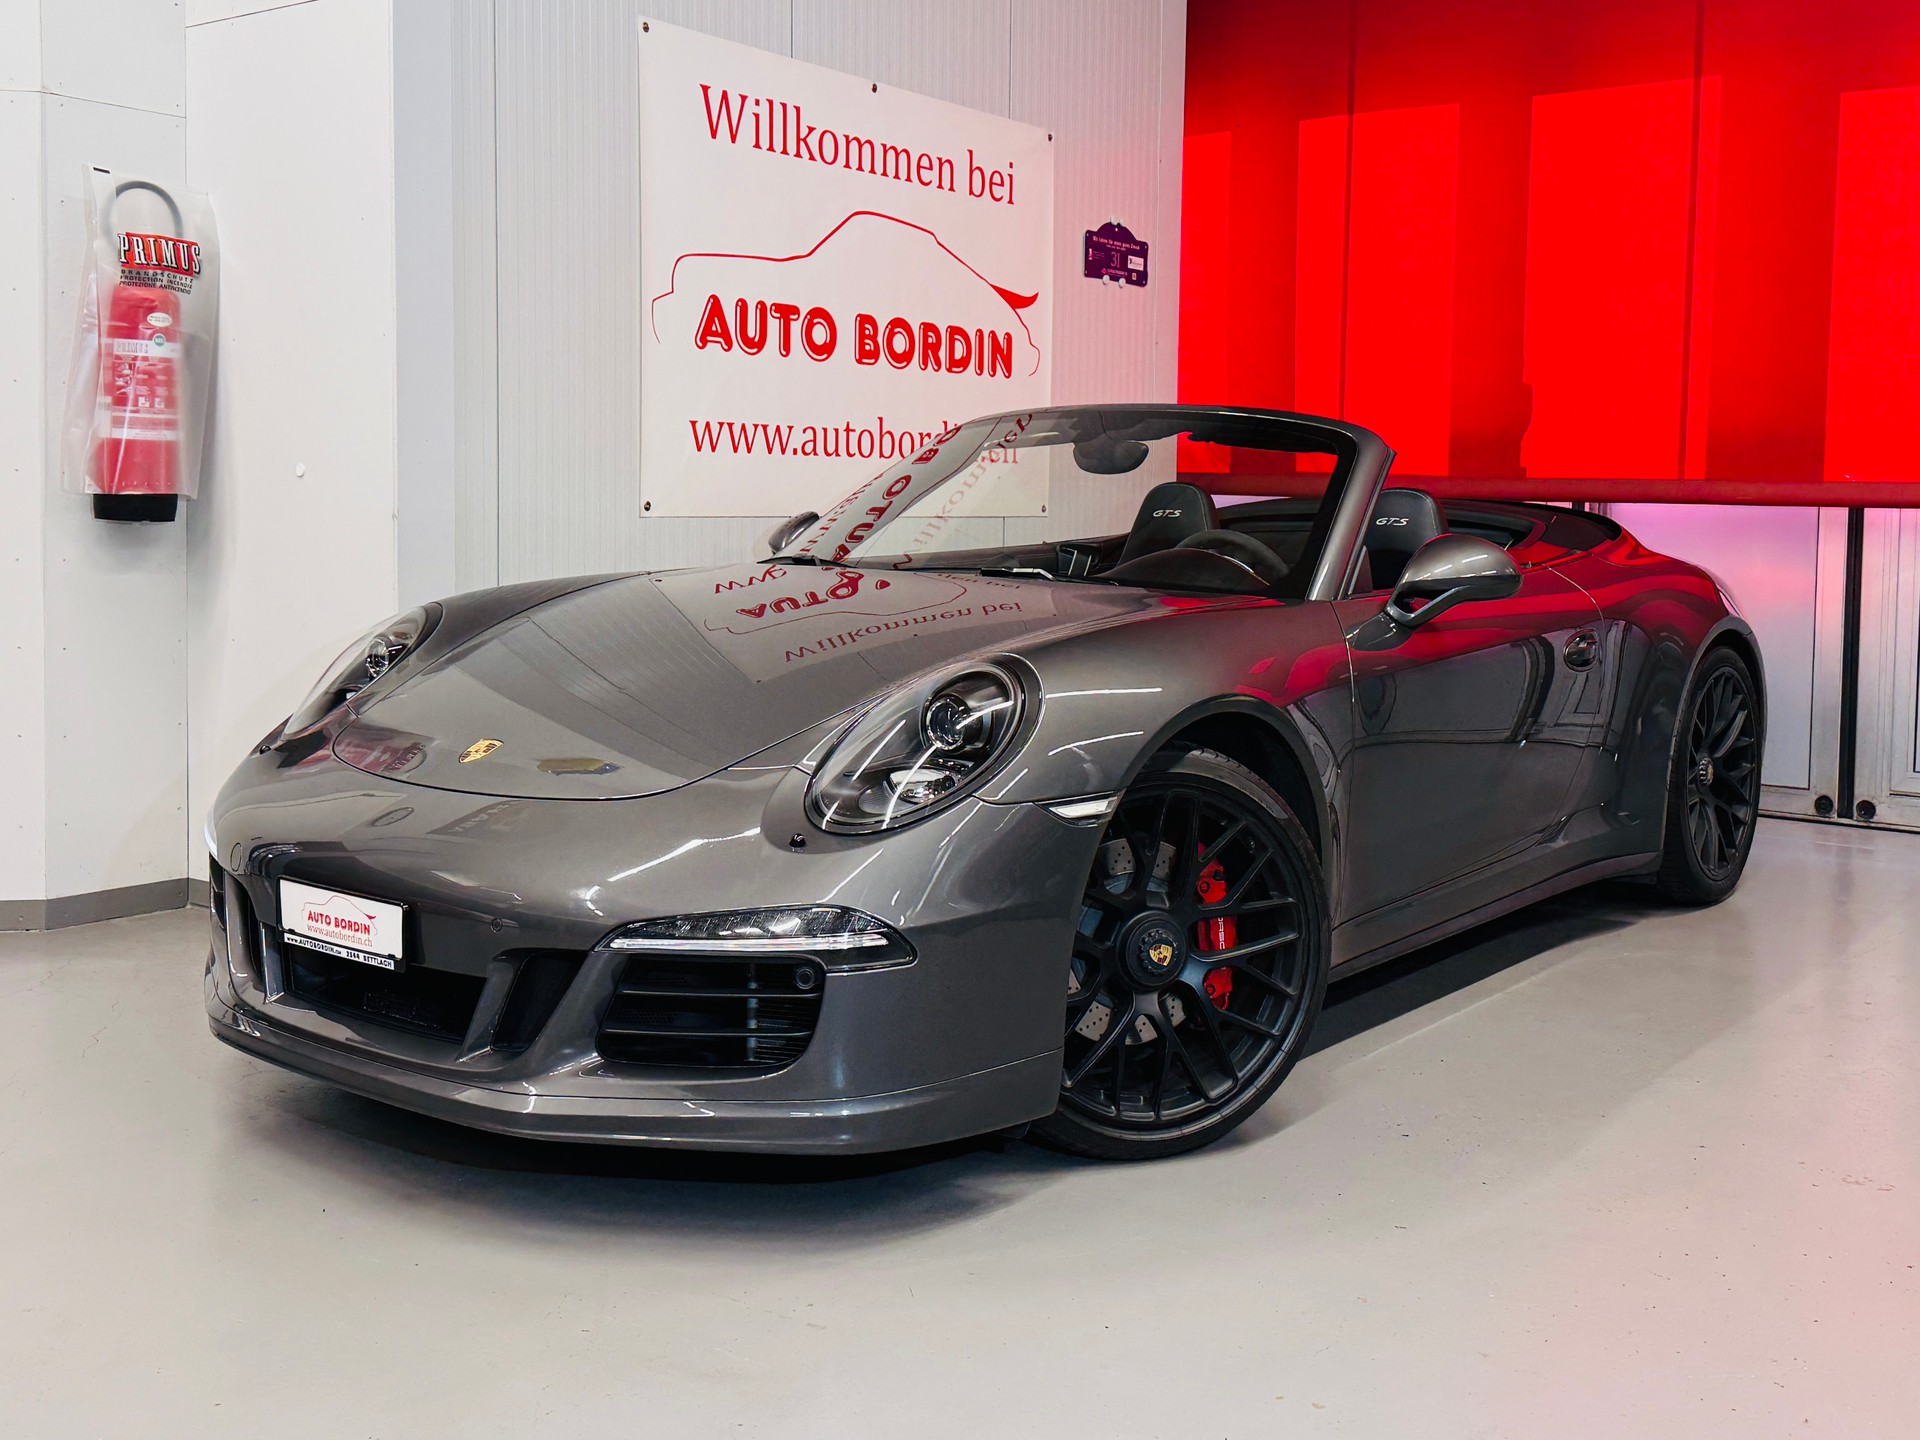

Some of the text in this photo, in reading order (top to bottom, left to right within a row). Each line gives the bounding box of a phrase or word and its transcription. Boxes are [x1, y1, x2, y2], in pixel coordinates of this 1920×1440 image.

[699, 83, 1015, 205] Willkommen bei
[117, 233, 201, 275] PRIMUS
[1110, 251, 1120, 268] 31
[120, 275, 193, 289] PROTECTION INCENDIE
[121, 269, 194, 284] BRANDSCHUTZ
[119, 280, 192, 295] PROTEZIONE ANTINCENDIO
[695, 293, 1013, 379] AUTO BORDIN
[1152, 509, 1182, 518] GTS
[1375, 517, 1409, 526] GTS
[307, 910, 371, 936] AUTO BORDIN
[306, 924, 373, 947] www.autobordin.ch
[363, 954, 392, 968] BETTLACH
